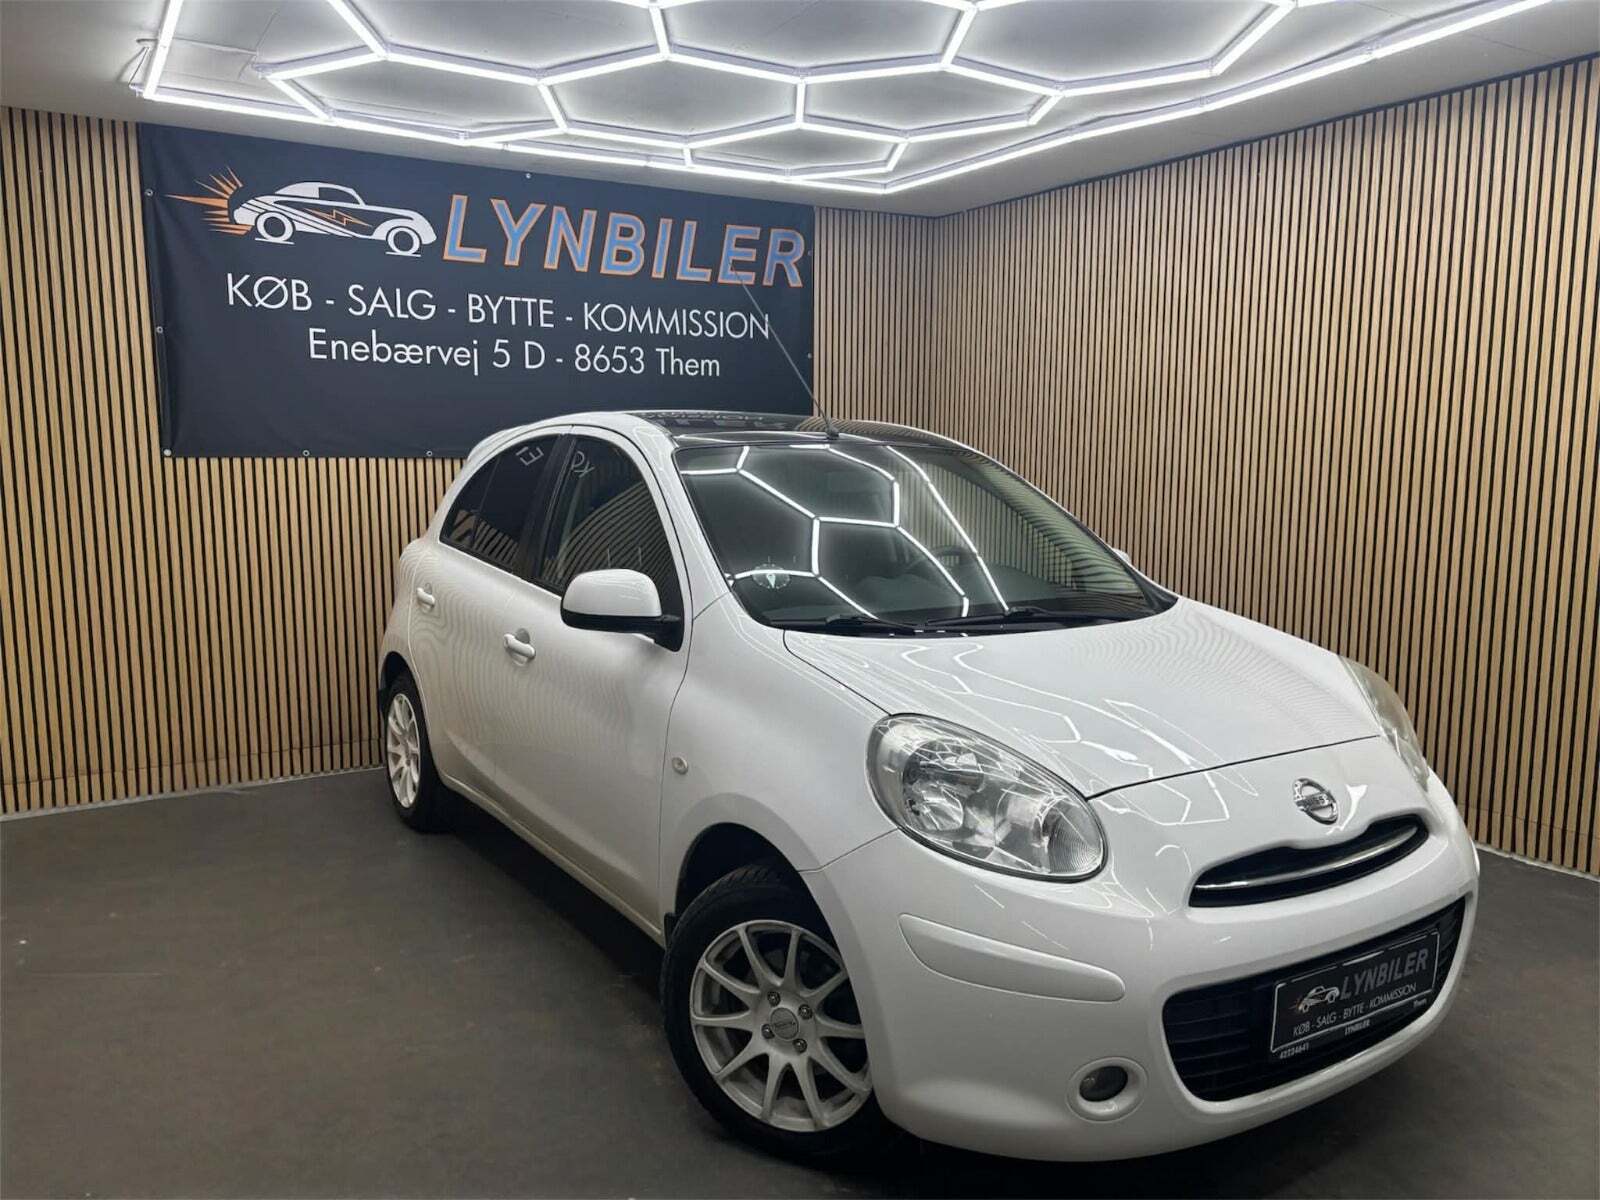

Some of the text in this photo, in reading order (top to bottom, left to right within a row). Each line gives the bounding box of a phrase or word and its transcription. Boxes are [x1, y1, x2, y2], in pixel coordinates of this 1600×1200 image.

[442, 194, 806, 288] LYNBILER
[227, 273, 312, 311] KØB
[348, 284, 437, 321] SALG
[468, 293, 555, 329] BYTTE
[583, 302, 769, 339] KOMMISSION
[309, 327, 479, 376] Enebærvej
[492, 339, 511, 369] 5
[524, 341, 546, 369] D
[574, 343, 645, 374] 8653
[656, 346, 720, 377] Them
[1340, 949, 1429, 1000] LYNBILER
[1316, 1011, 1337, 1030] SALG
[1343, 1001, 1366, 1020] BYTTE
